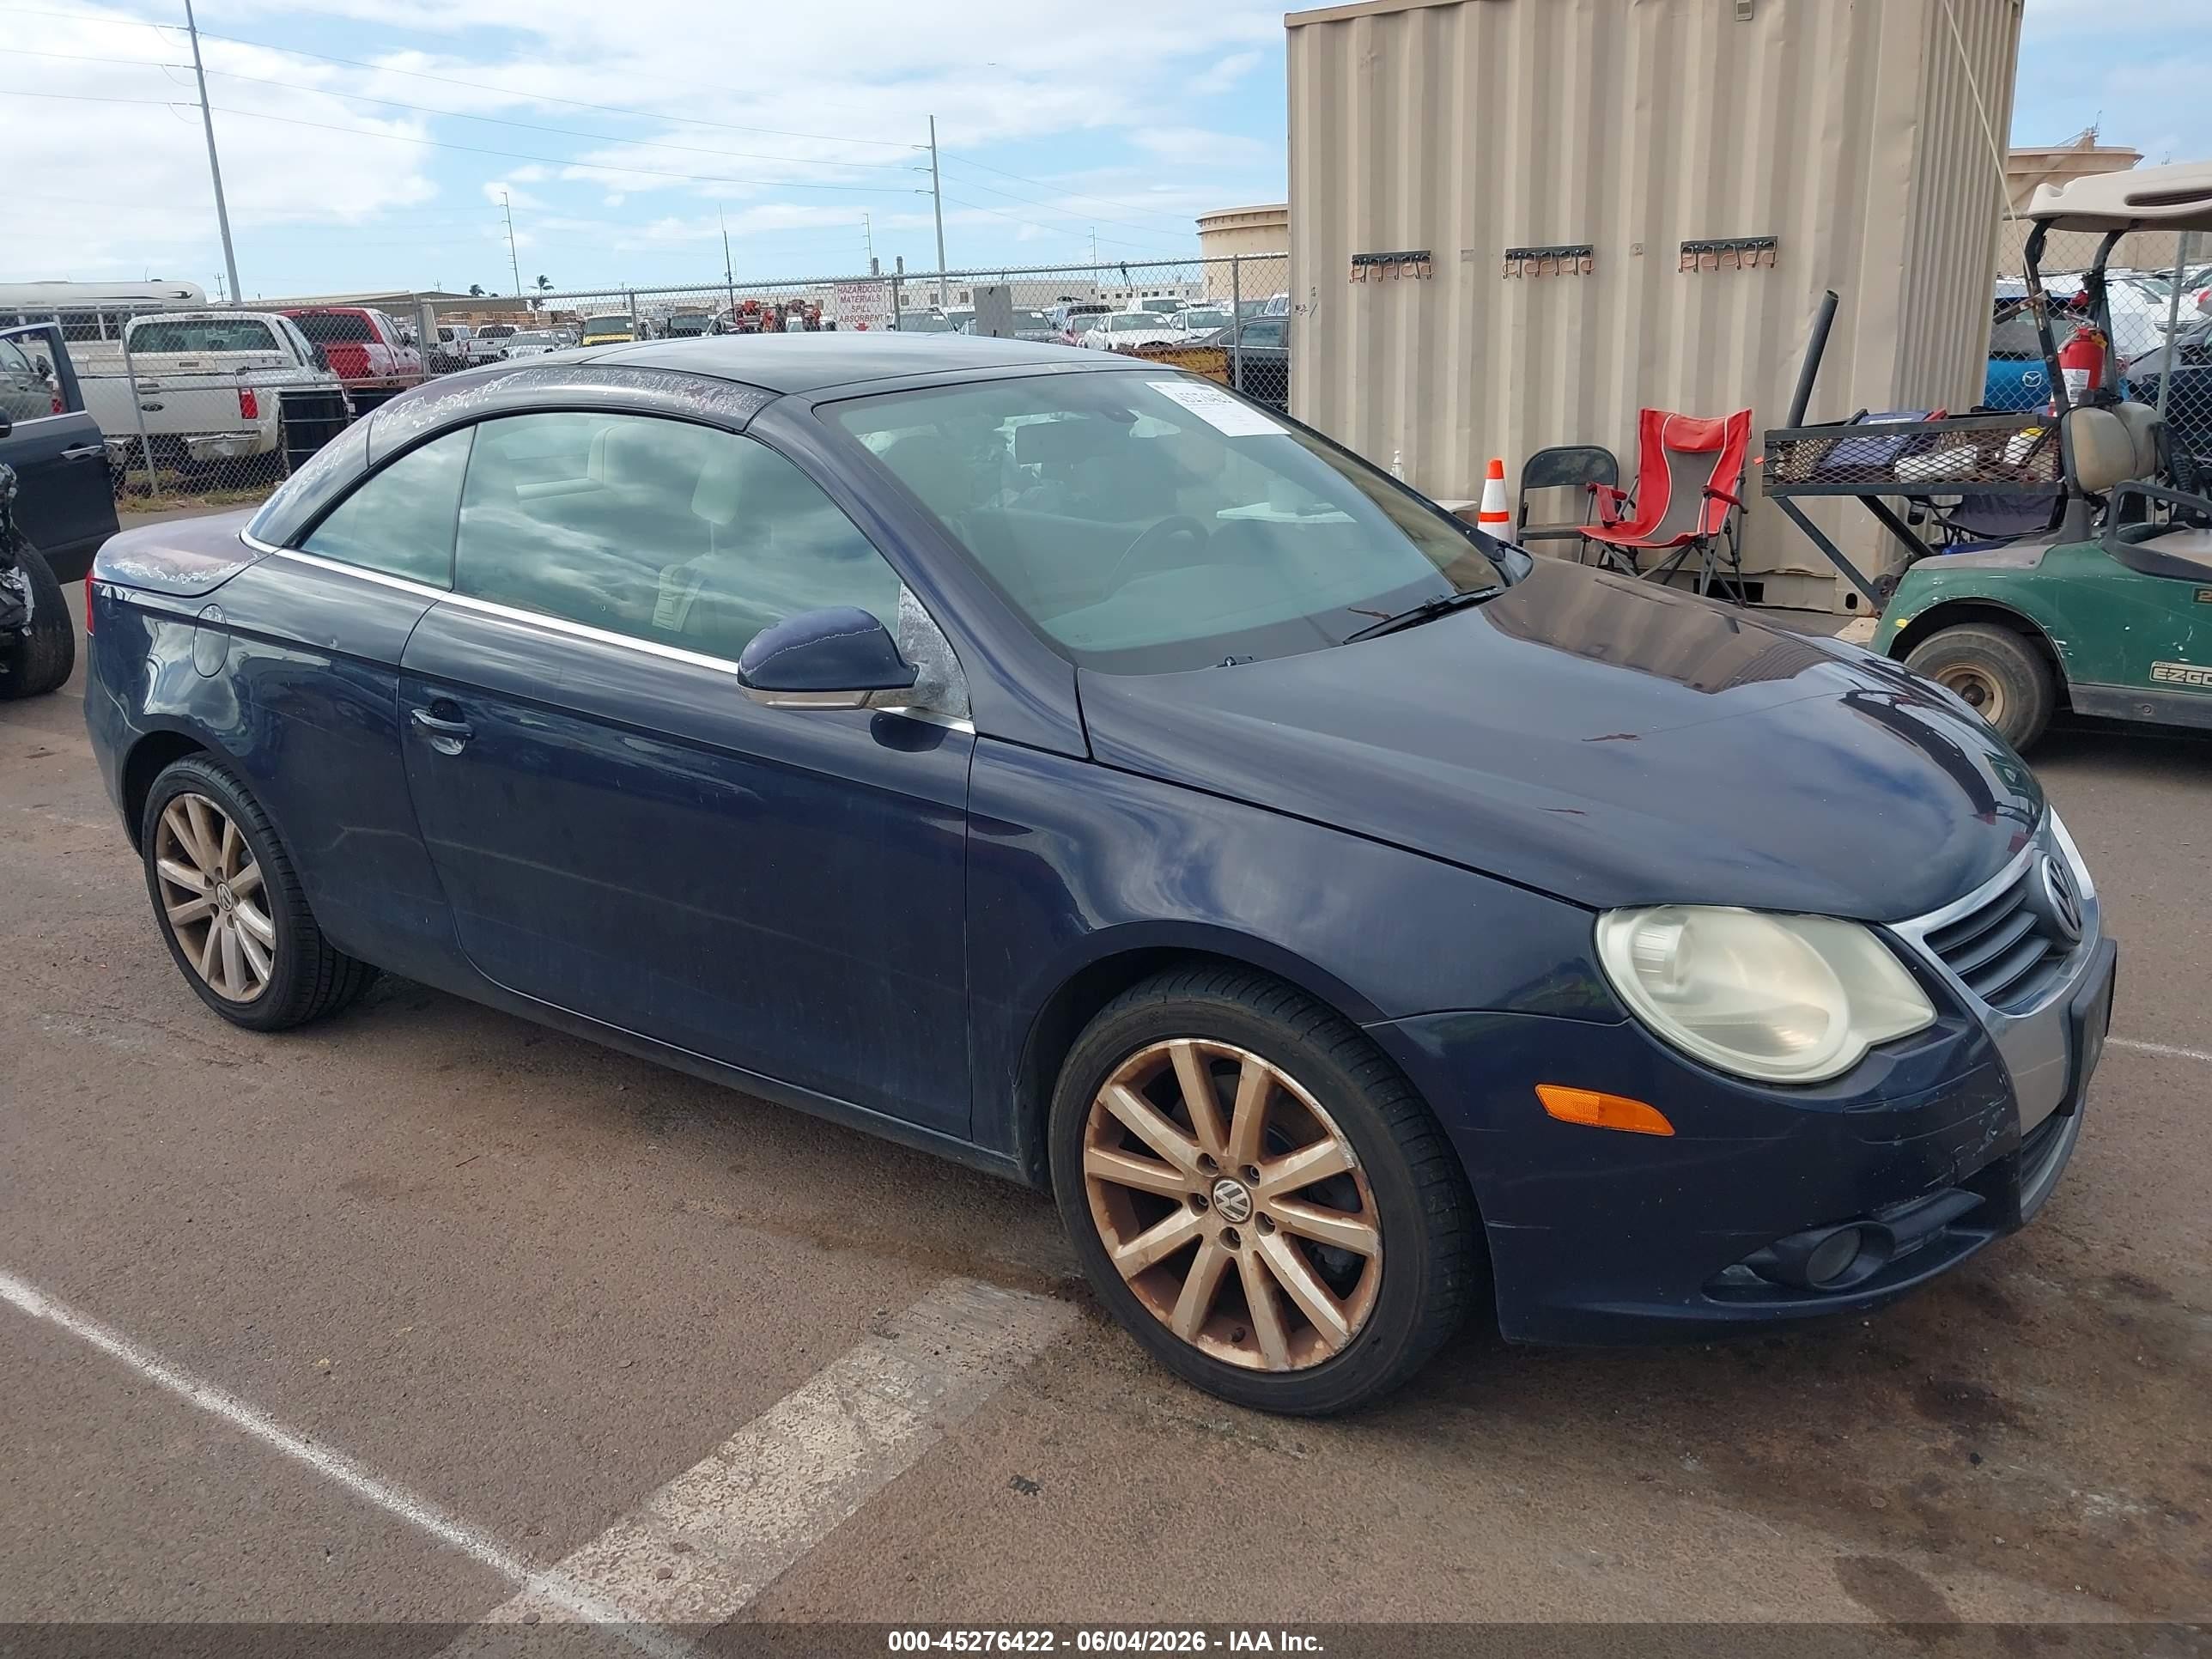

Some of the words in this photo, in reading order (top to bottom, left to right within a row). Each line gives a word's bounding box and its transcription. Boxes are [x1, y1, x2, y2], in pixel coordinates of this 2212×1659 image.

[837, 285, 883, 294] HAZARDOUS
[840, 295, 881, 303] MATERIALS
[838, 313, 884, 323] ABSORBENT
